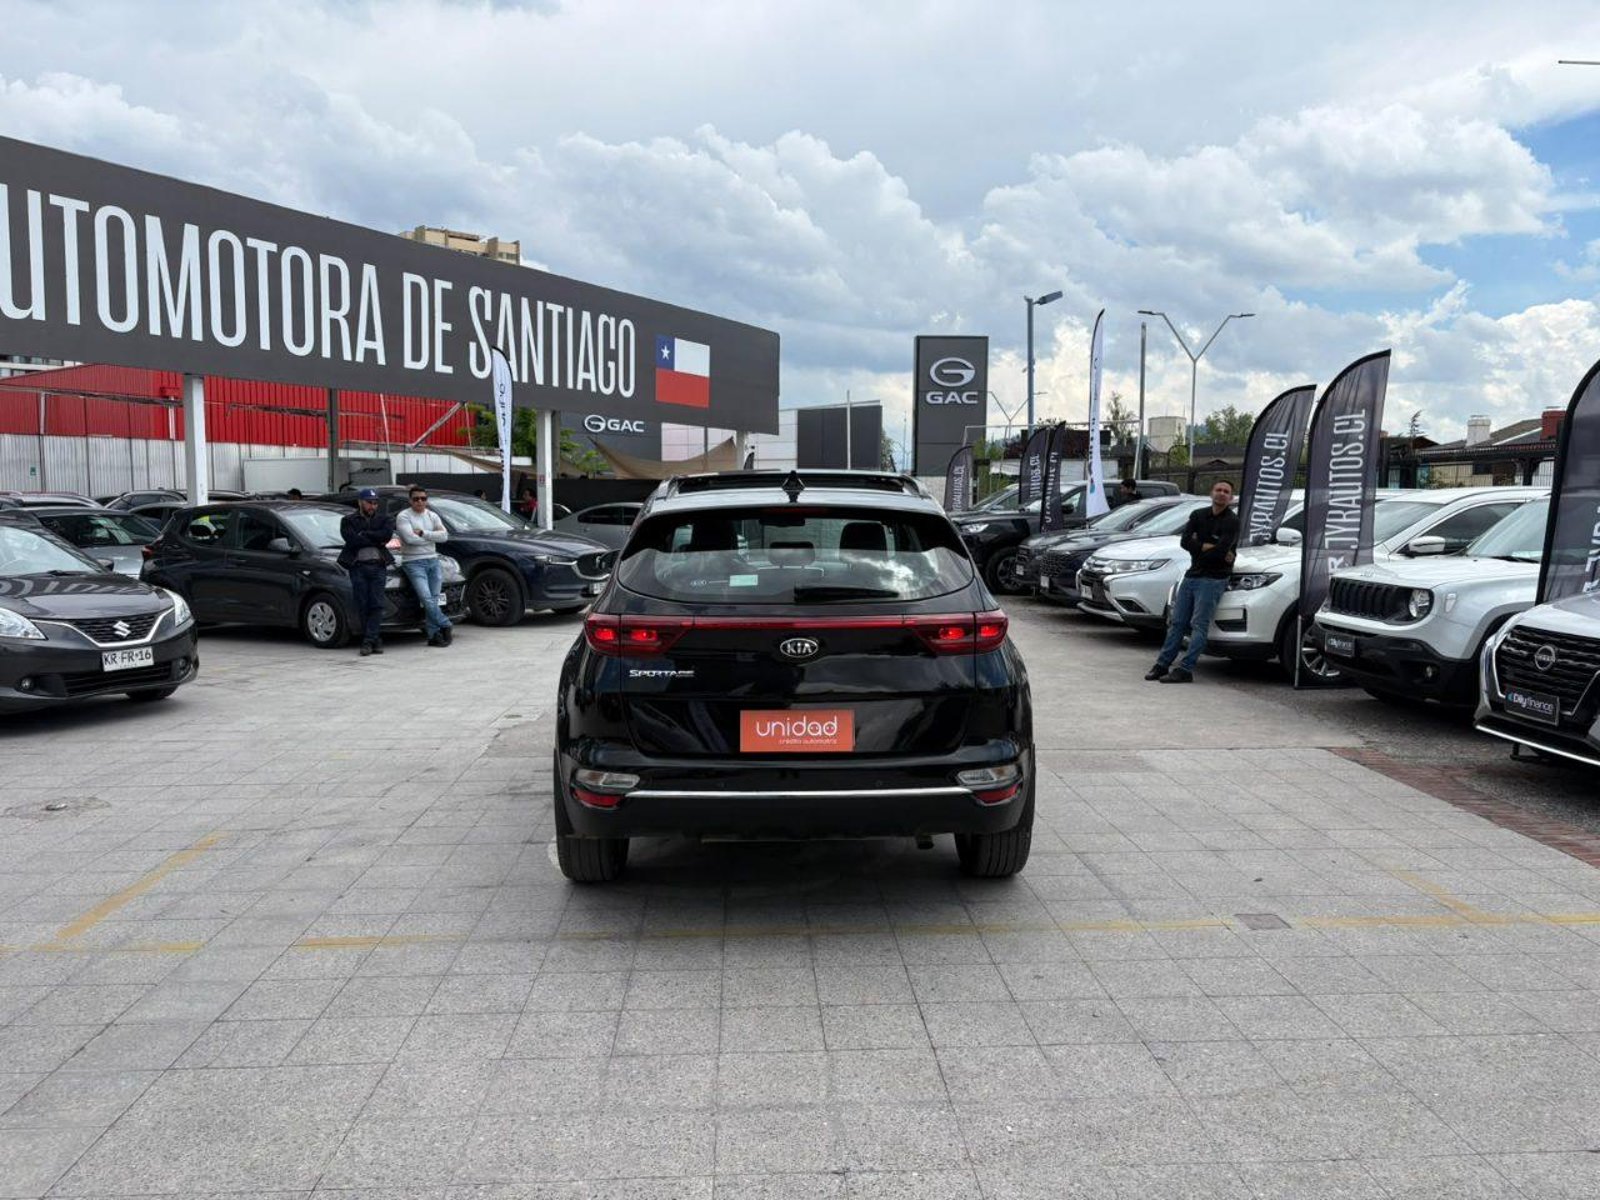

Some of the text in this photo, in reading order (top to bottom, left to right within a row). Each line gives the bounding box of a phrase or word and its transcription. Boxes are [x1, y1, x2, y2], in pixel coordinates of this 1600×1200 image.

[402, 271, 454, 374] DE
[468, 285, 636, 398] SANTIAGO
[926, 391, 978, 404] GAC
[606, 418, 645, 433] GAC
[1249, 430, 1290, 543] JYRAUTOS.CL
[1324, 408, 1367, 549] JYRAUTOS.CL
[786, 642, 813, 654] KIA
[756, 715, 838, 736] unidad
